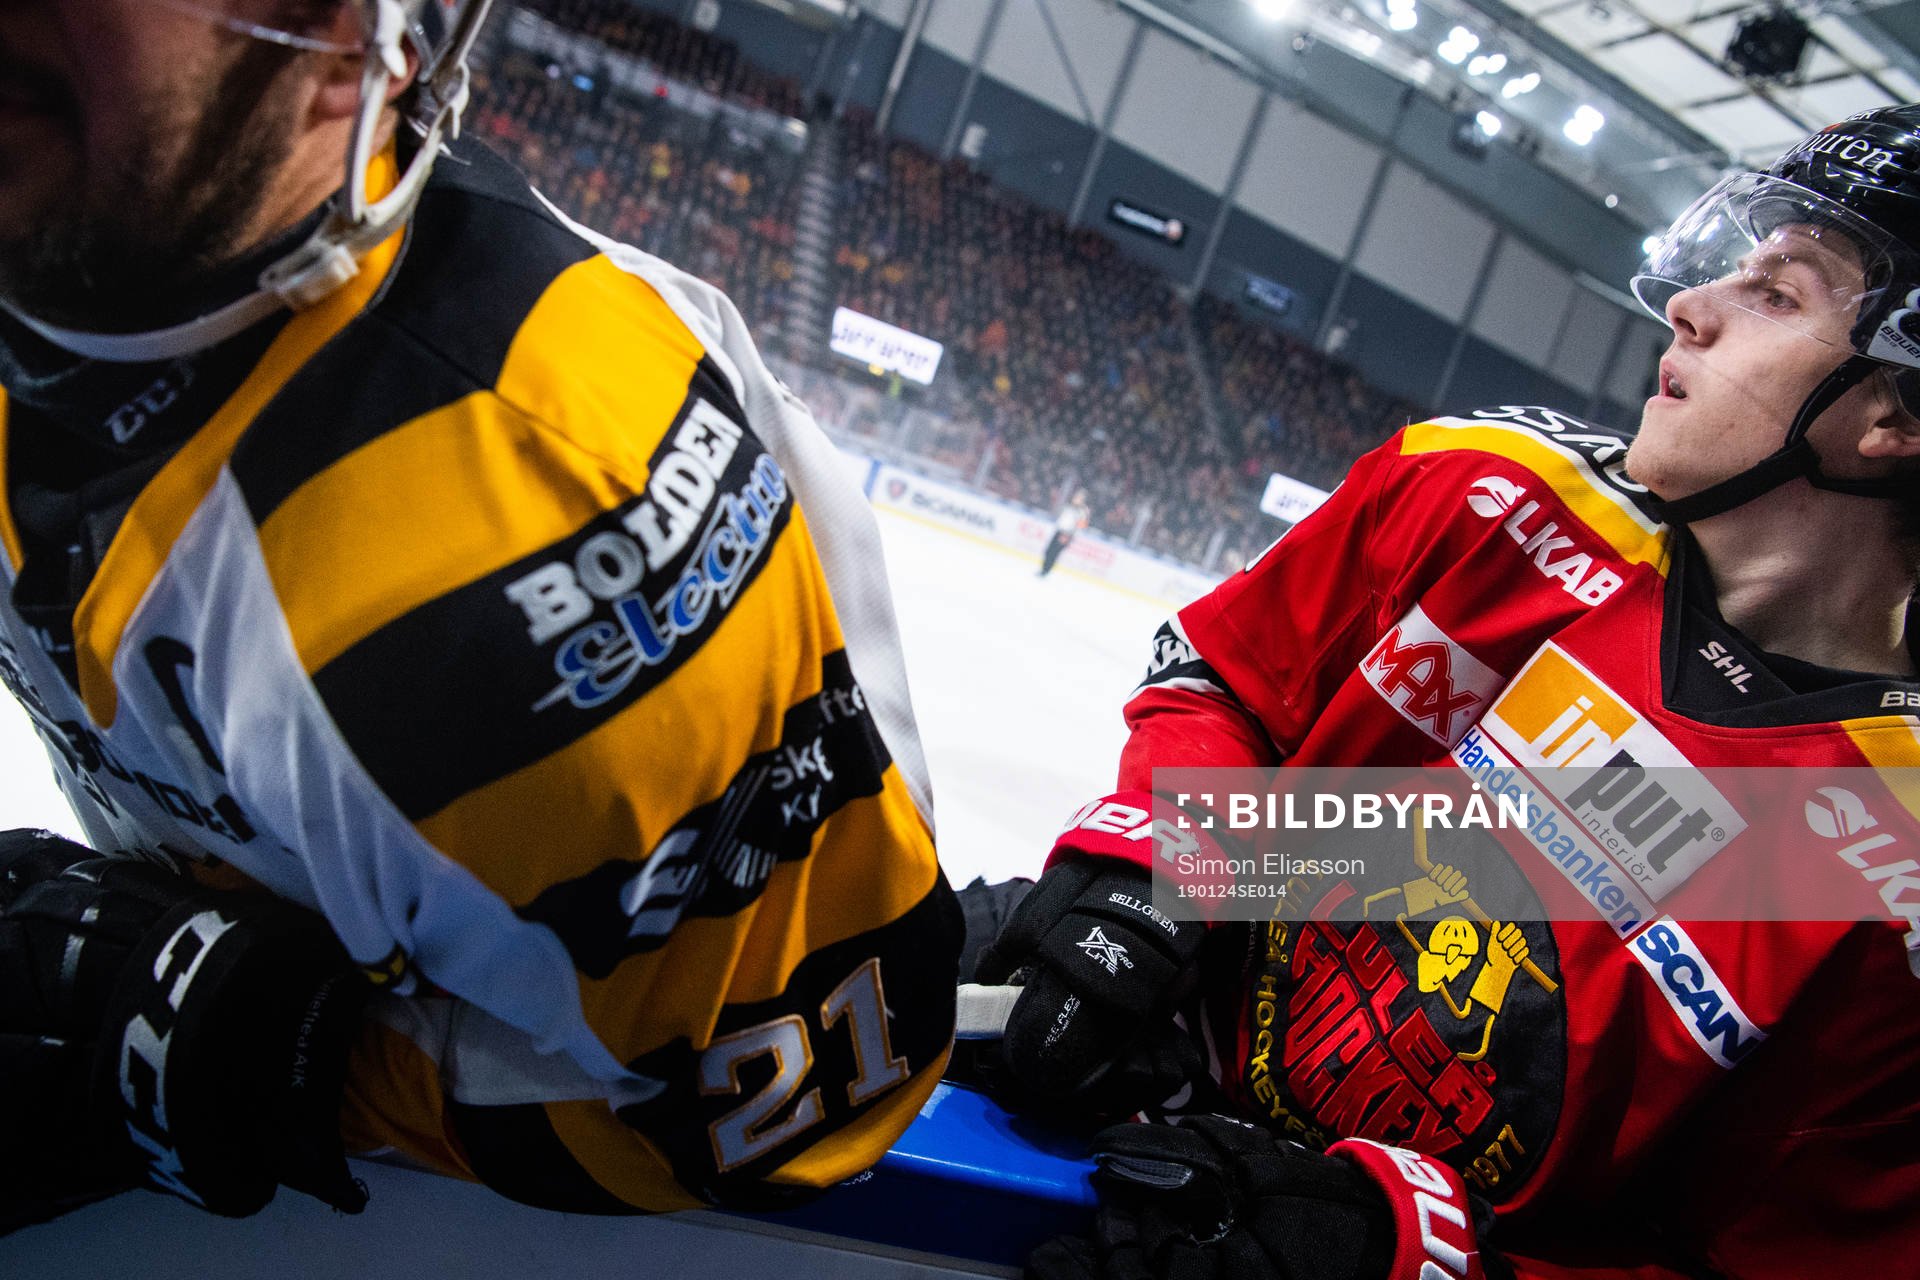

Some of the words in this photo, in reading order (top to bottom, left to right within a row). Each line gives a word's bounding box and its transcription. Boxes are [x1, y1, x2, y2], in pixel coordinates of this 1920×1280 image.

[105, 366, 192, 443] CC
[504, 397, 743, 646] BOLIDEN
[1504, 500, 1623, 607] LKAB
[530, 453, 787, 713] Electro
[1363, 623, 1483, 742] MAX
[1699, 640, 1752, 694] SHL
[1062, 800, 1195, 864] UER
[1455, 728, 1642, 930] Handelsbanken
[1581, 809, 1654, 885] interiör
[1084, 948, 1119, 977] LITE
[1109, 892, 1180, 936] SELLGREN
[1283, 924, 1463, 1156] HOCKEY
[1309, 880, 1497, 1136] LULEÅ
[1636, 923, 1758, 1064] SCAN
[699, 956, 912, 1174] 21
[1463, 1124, 1525, 1188] 1977
